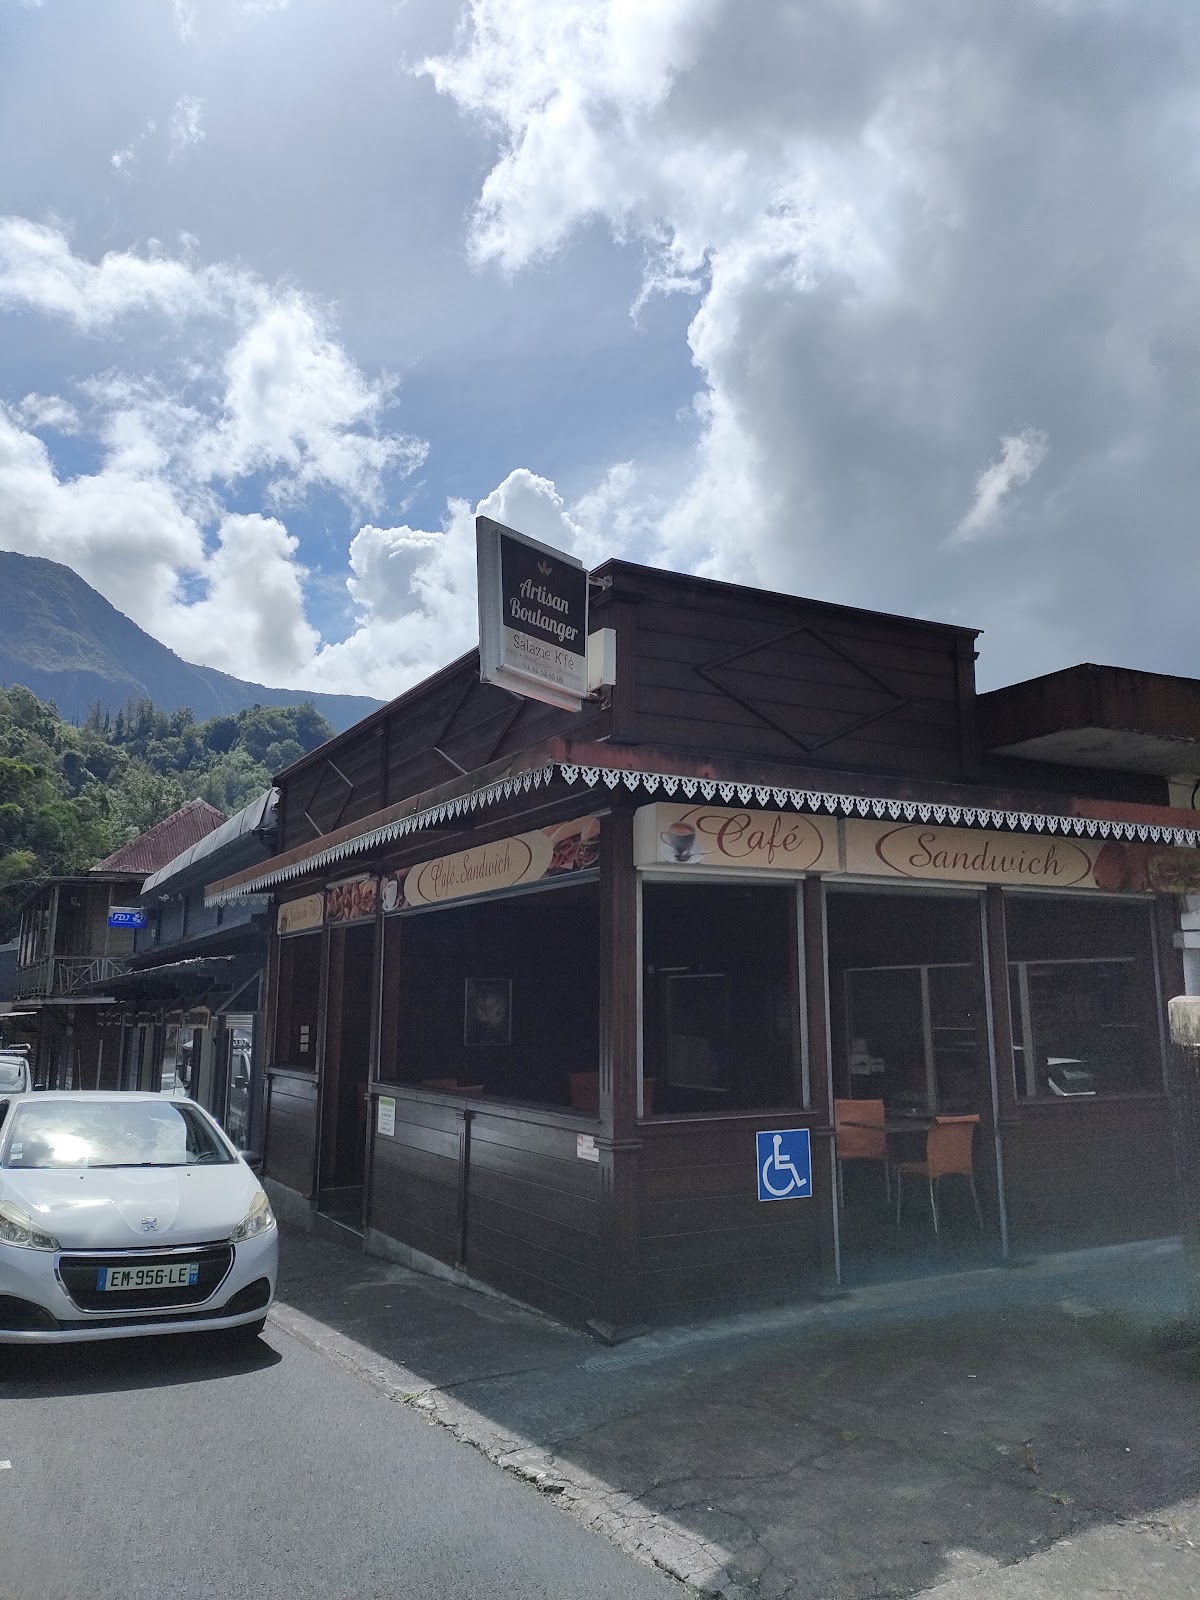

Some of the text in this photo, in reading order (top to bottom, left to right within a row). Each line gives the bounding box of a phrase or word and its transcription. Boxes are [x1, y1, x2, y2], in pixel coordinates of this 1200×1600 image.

[520, 578, 570, 615] Artisan
[509, 597, 579, 643] Boulanger
[513, 634, 551, 660] Salazie
[696, 813, 804, 865] Café
[908, 832, 1065, 876] Sandwich
[114, 914, 130, 922] FDJ
[111, 1267, 188, 1287] EM-956-LE
